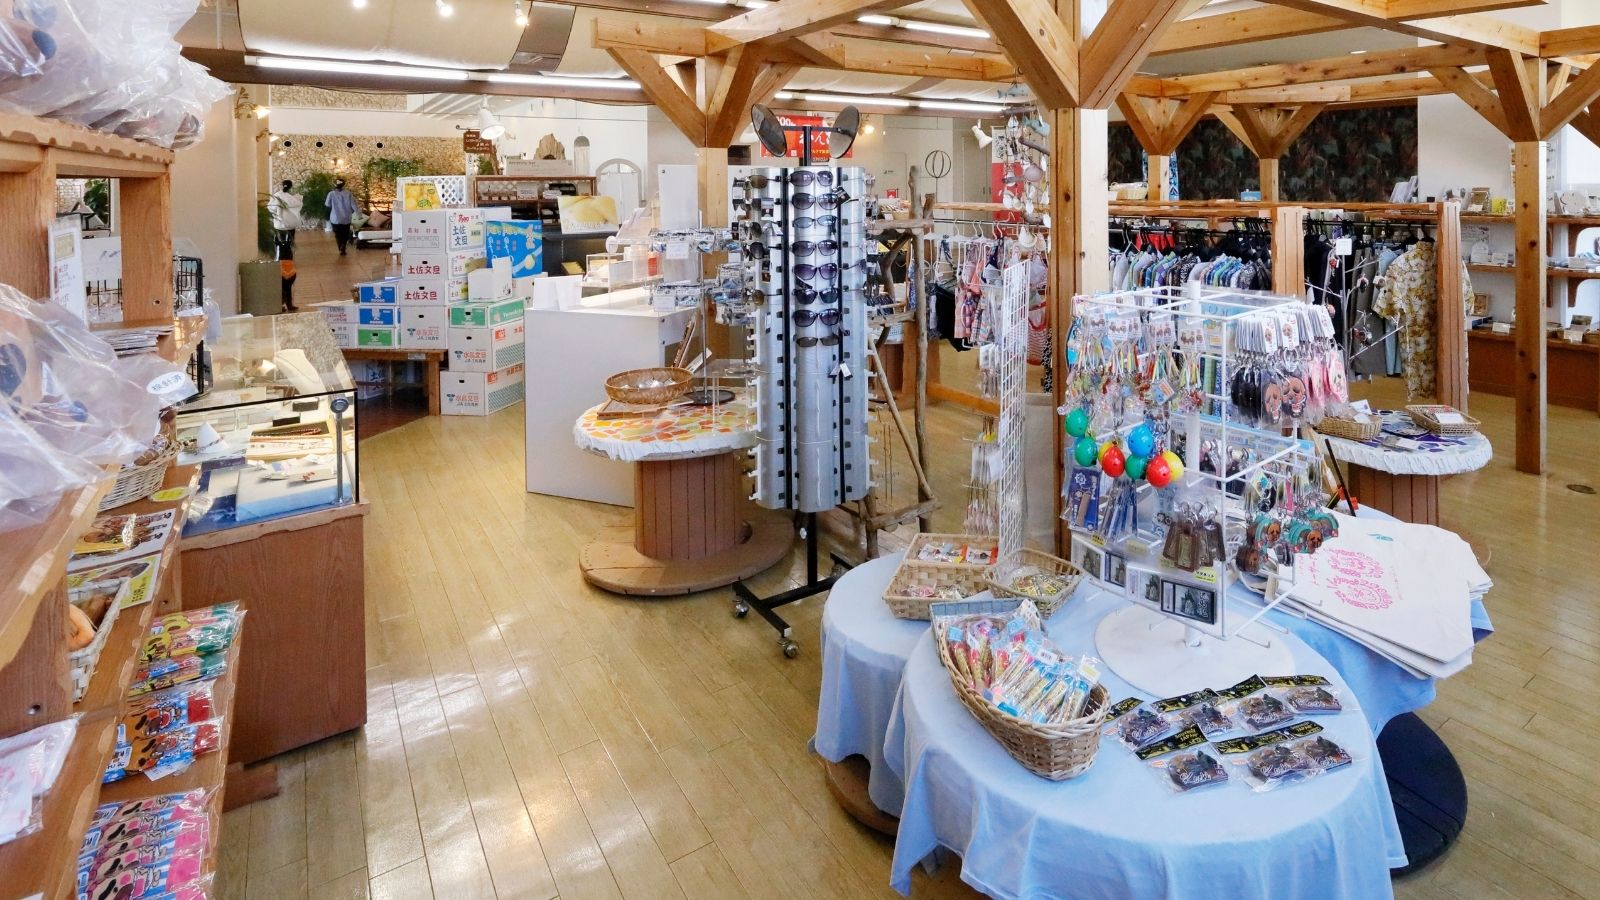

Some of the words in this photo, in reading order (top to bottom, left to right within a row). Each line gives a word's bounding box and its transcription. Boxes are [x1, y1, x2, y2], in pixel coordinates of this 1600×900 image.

[408, 265, 440, 275] 土佐文旦
[404, 291, 438, 301] 土佐文旦
